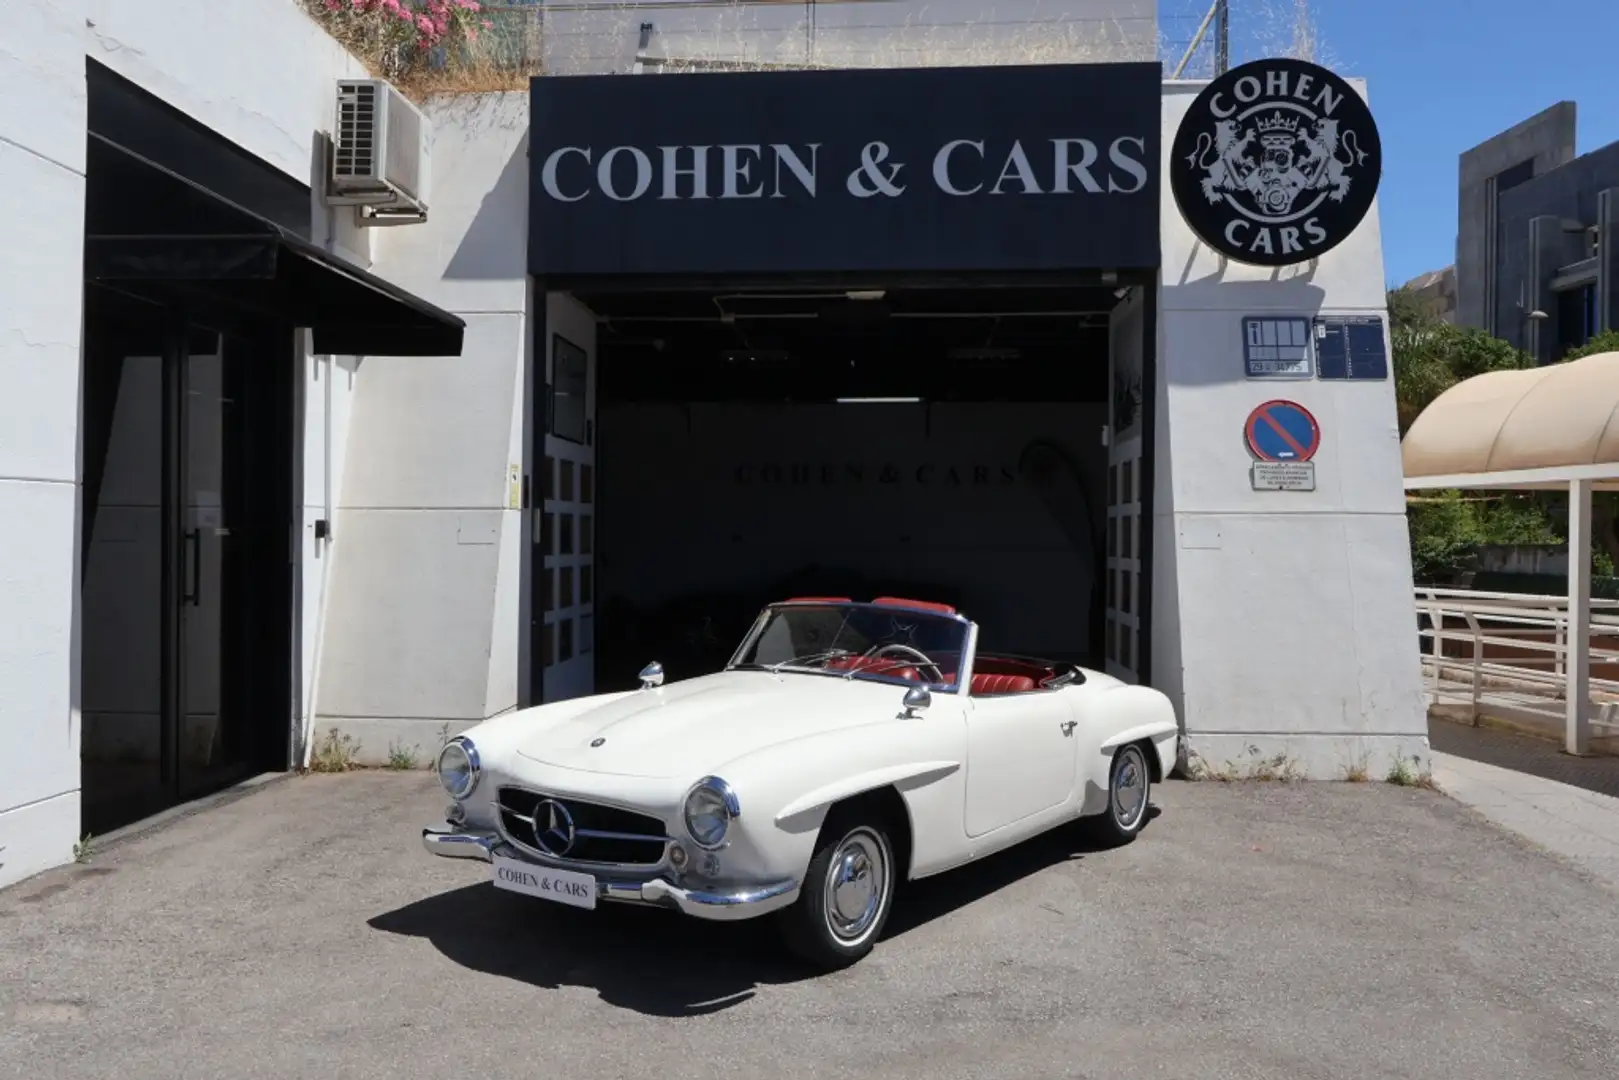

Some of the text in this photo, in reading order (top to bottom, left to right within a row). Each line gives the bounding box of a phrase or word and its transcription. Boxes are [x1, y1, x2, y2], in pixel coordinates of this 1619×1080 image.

[1209, 70, 1345, 118] COHEN
[541, 136, 1148, 202] COHEN & CARS
[1224, 217, 1327, 255] CARS
[733, 463, 1016, 484] COHEN & CARS
[498, 867, 588, 897] COHEN & CARS
